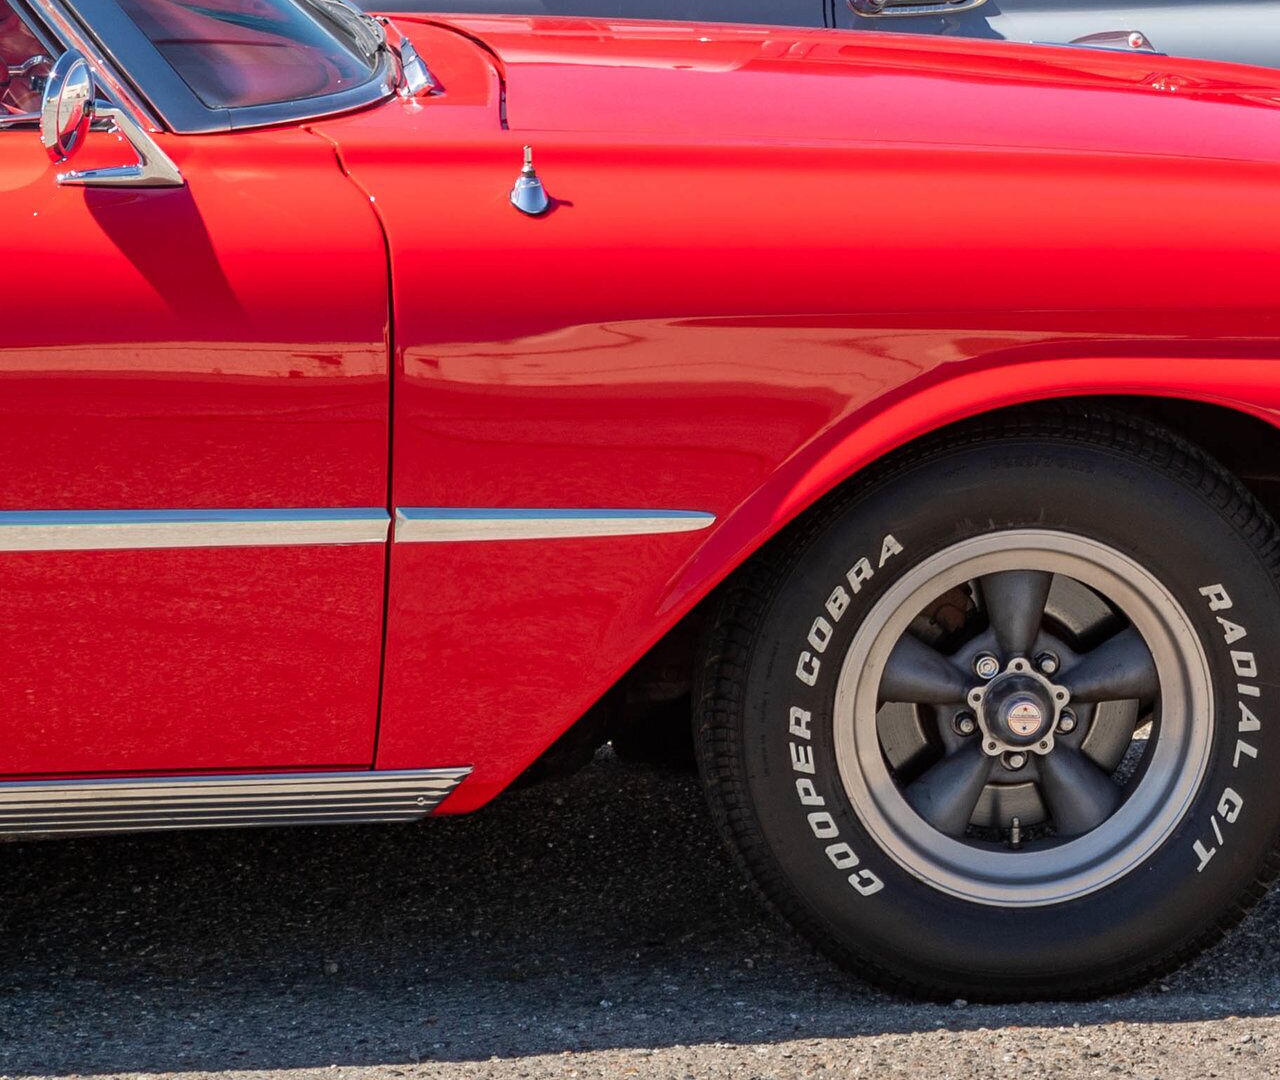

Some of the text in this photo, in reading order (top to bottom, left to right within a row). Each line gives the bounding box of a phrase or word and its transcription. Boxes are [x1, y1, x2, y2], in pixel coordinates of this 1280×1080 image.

[788, 534, 904, 897] COOPER COBRA
[1192, 583, 1262, 873] RADIAL G/T
